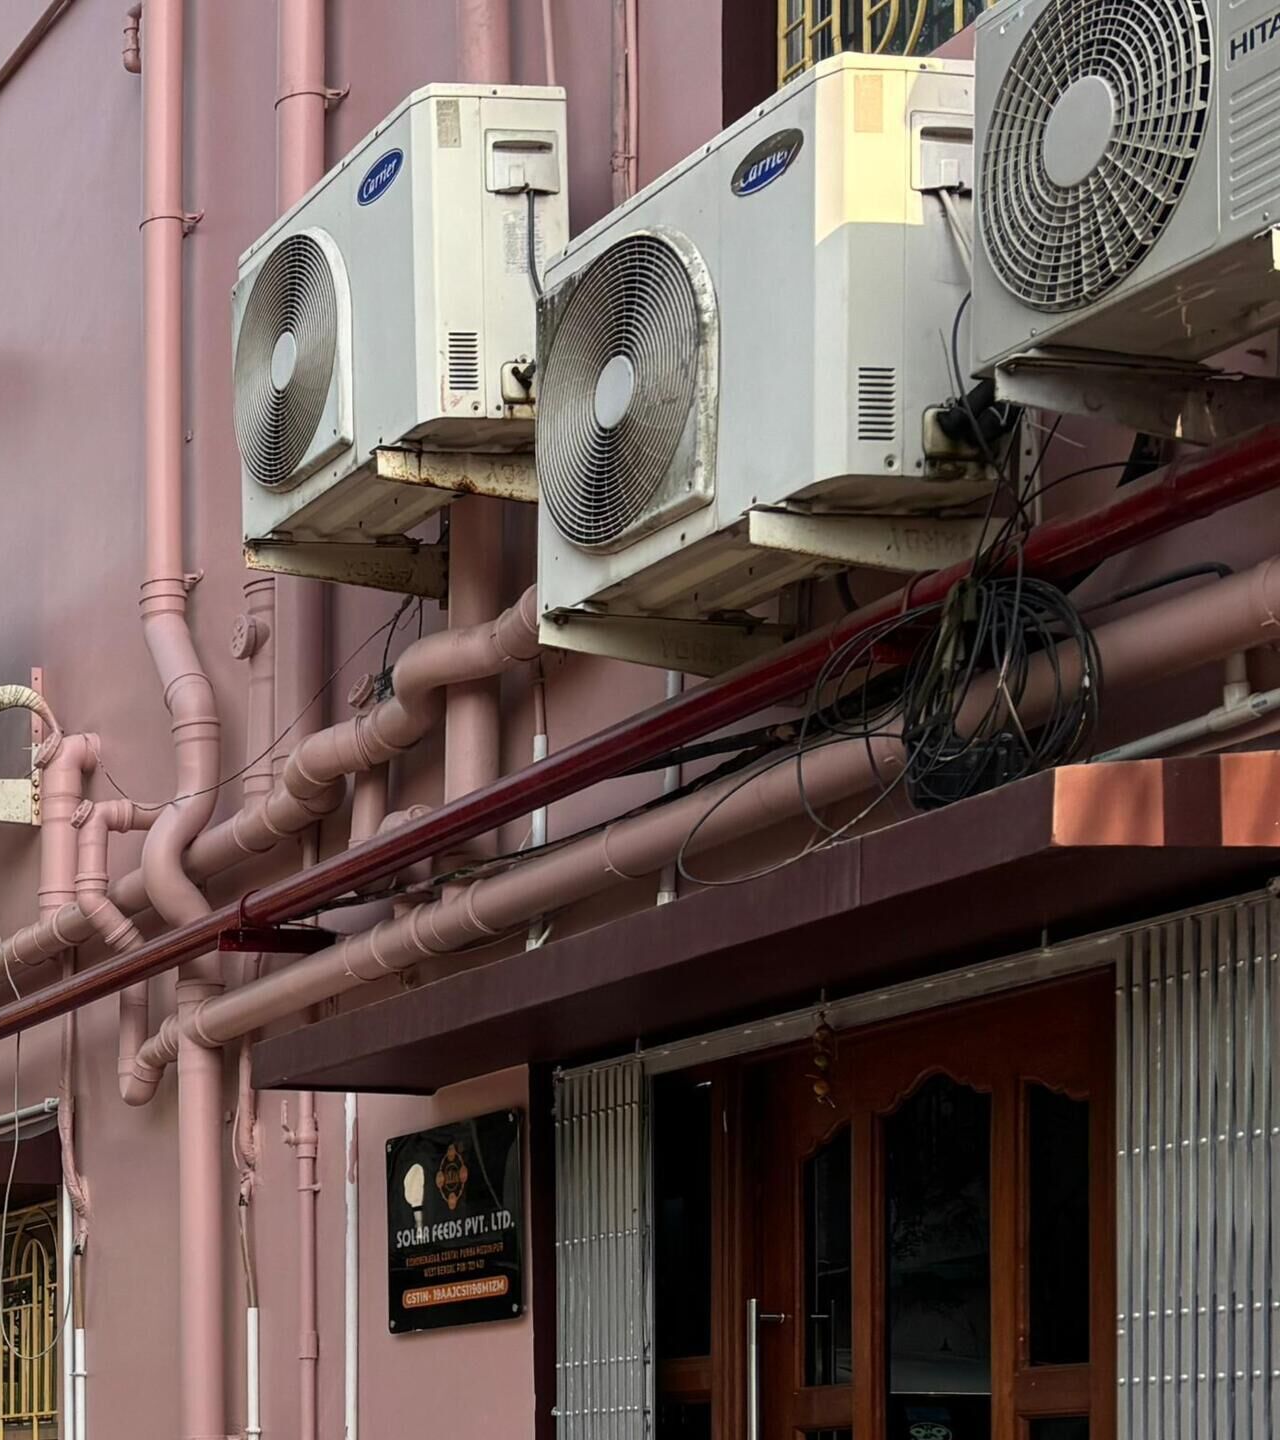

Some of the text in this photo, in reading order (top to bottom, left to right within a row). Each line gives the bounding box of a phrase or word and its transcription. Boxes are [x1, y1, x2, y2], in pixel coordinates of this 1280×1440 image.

[363, 158, 397, 199] Carrier
[396, 1210, 515, 1248] SOLAR FEEDS PVT. LTD.
